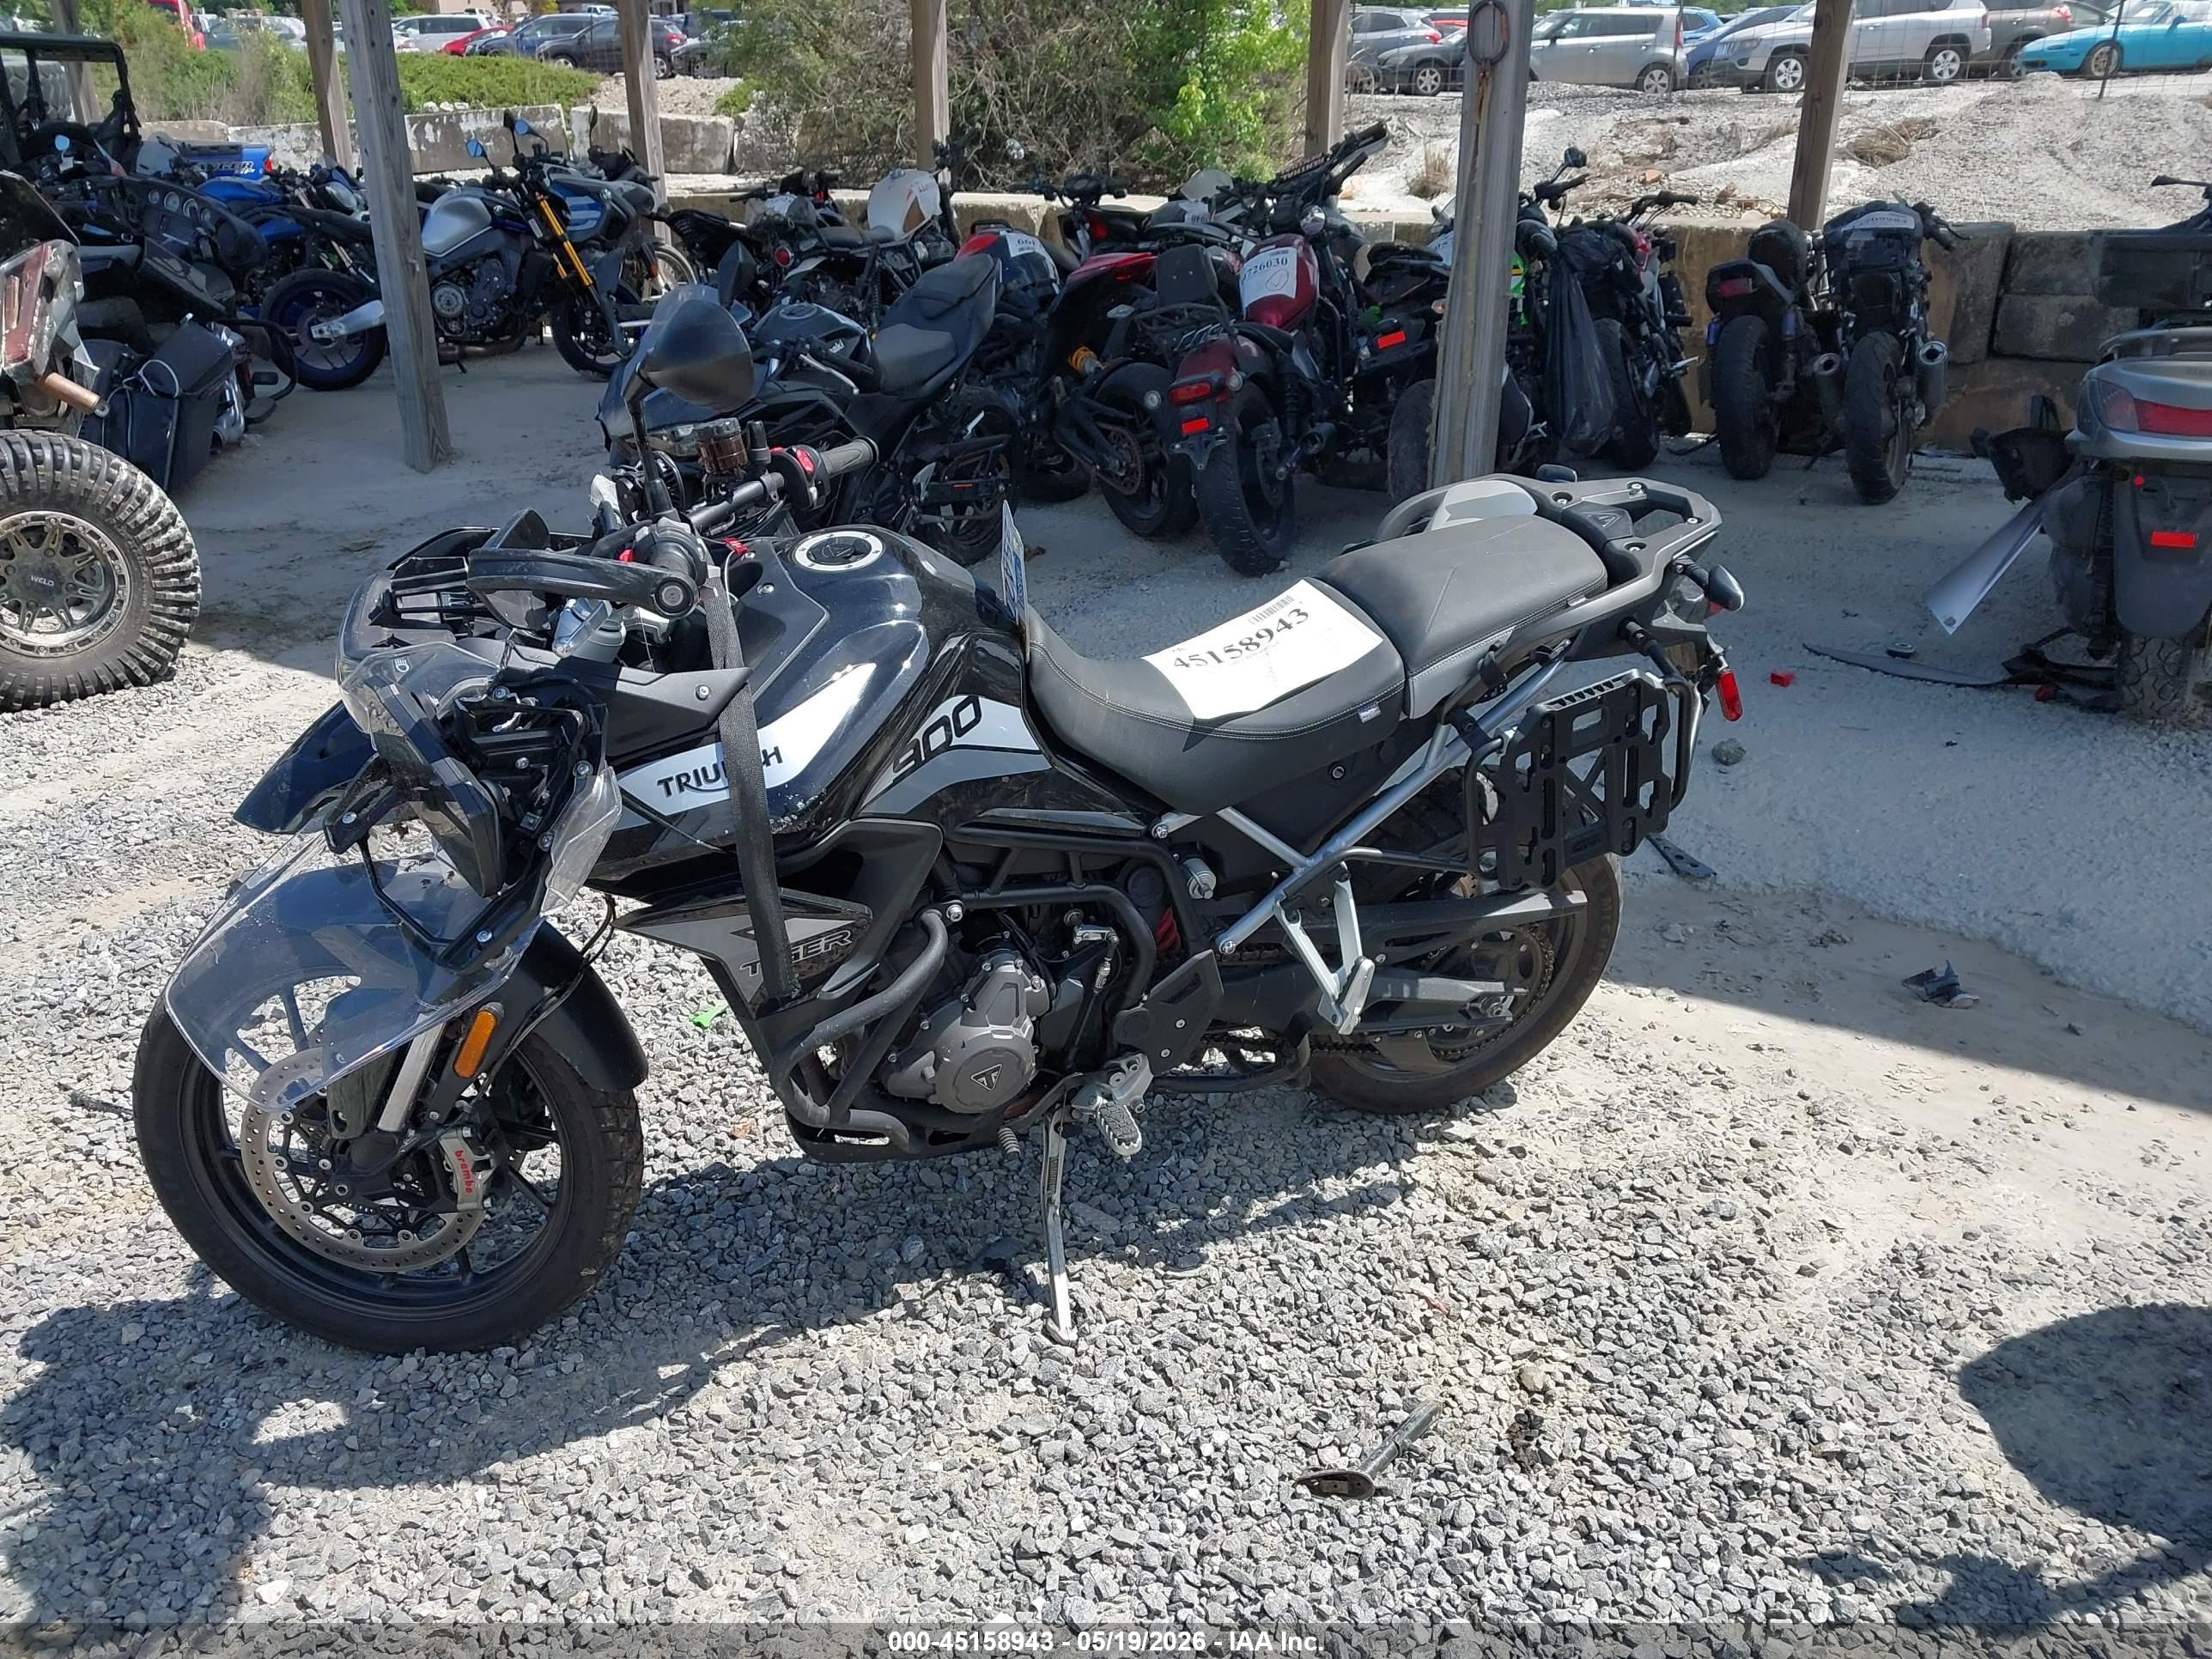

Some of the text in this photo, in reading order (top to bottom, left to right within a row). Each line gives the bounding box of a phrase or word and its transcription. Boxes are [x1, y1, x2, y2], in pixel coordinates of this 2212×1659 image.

[31, 574, 54, 587] WELD
[1174, 608, 1309, 668] 45158943
[893, 696, 982, 779] 900
[657, 746, 783, 798] TRIUH
[739, 930, 853, 977] TER
[454, 1149, 475, 1194] brembo
